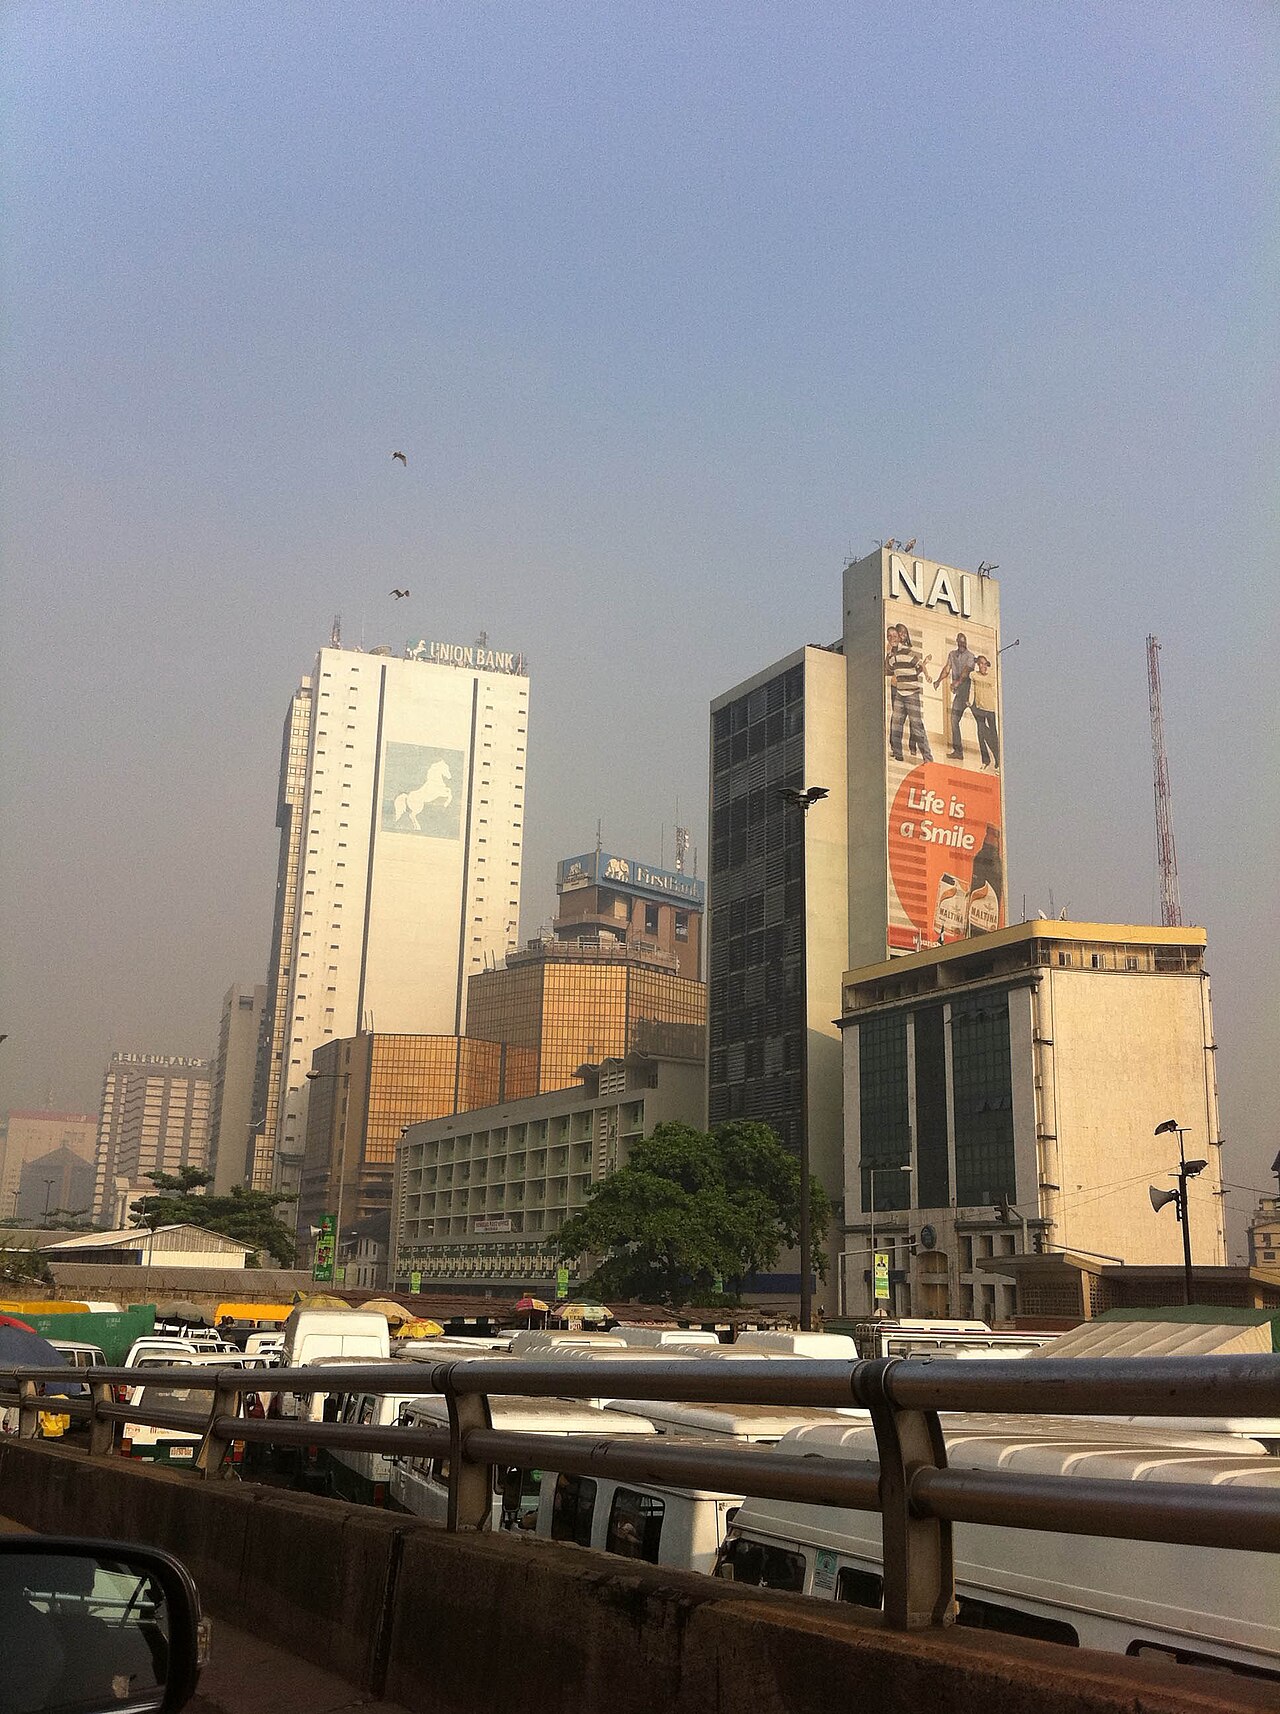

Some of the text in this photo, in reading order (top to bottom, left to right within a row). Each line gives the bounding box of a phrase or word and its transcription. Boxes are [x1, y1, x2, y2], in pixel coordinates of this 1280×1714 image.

[889, 554, 971, 618] NAI
[430, 641, 514, 669] UNION BANK
[907, 787, 965, 818] Life is
[899, 820, 975, 850] a Smile
[939, 907, 964, 924] MALTINA
[971, 906, 998, 923] MALTINA
